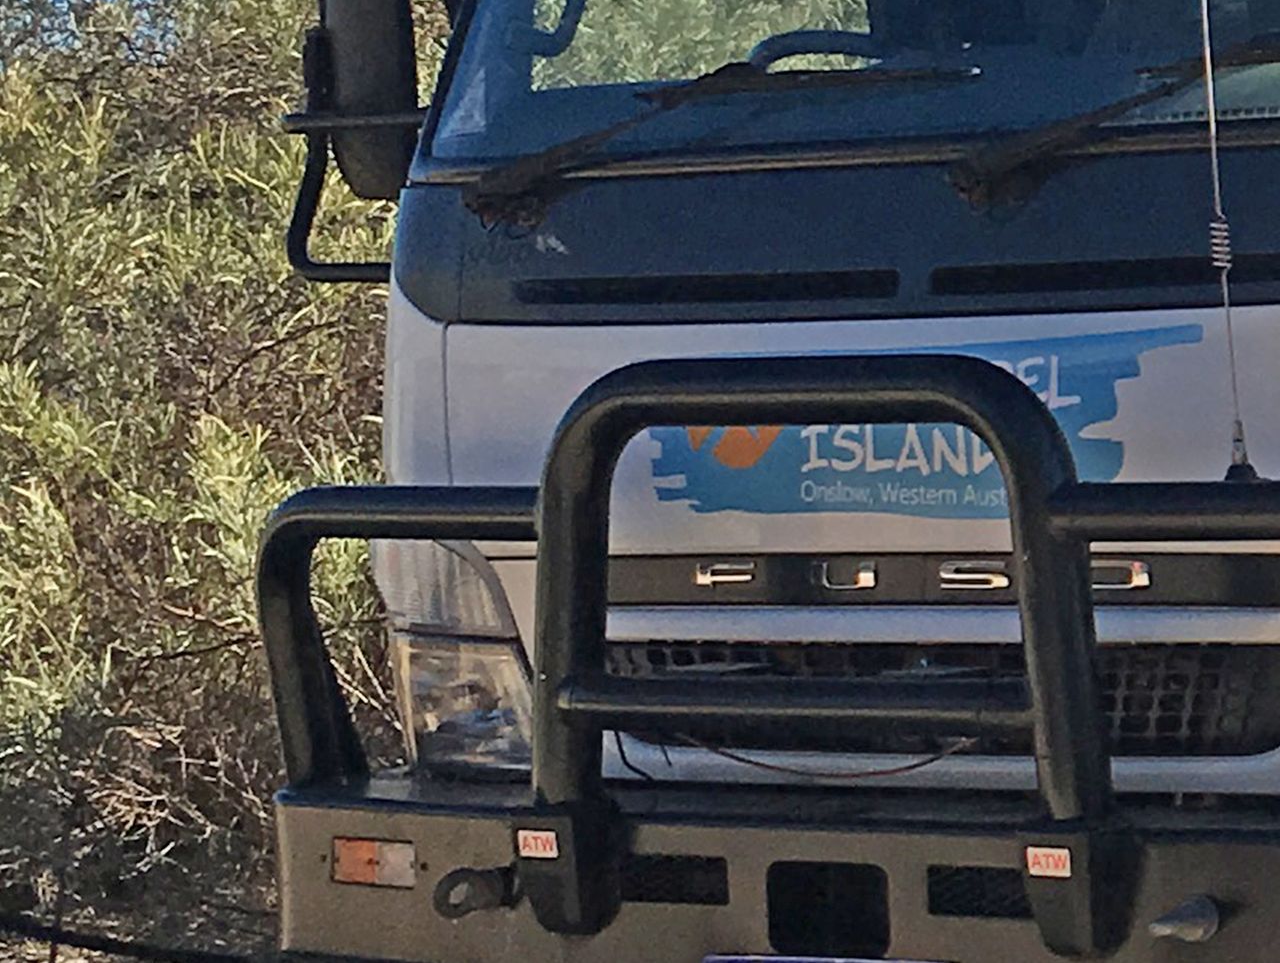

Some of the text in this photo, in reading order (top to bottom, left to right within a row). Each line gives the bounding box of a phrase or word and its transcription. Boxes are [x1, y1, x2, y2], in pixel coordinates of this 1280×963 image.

[801, 423, 997, 477] ISLAN
[878, 482, 957, 506] Western
[695, 559, 1150, 589] FUSO
[522, 836, 553, 852] ATW
[1031, 853, 1067, 870] ATW
